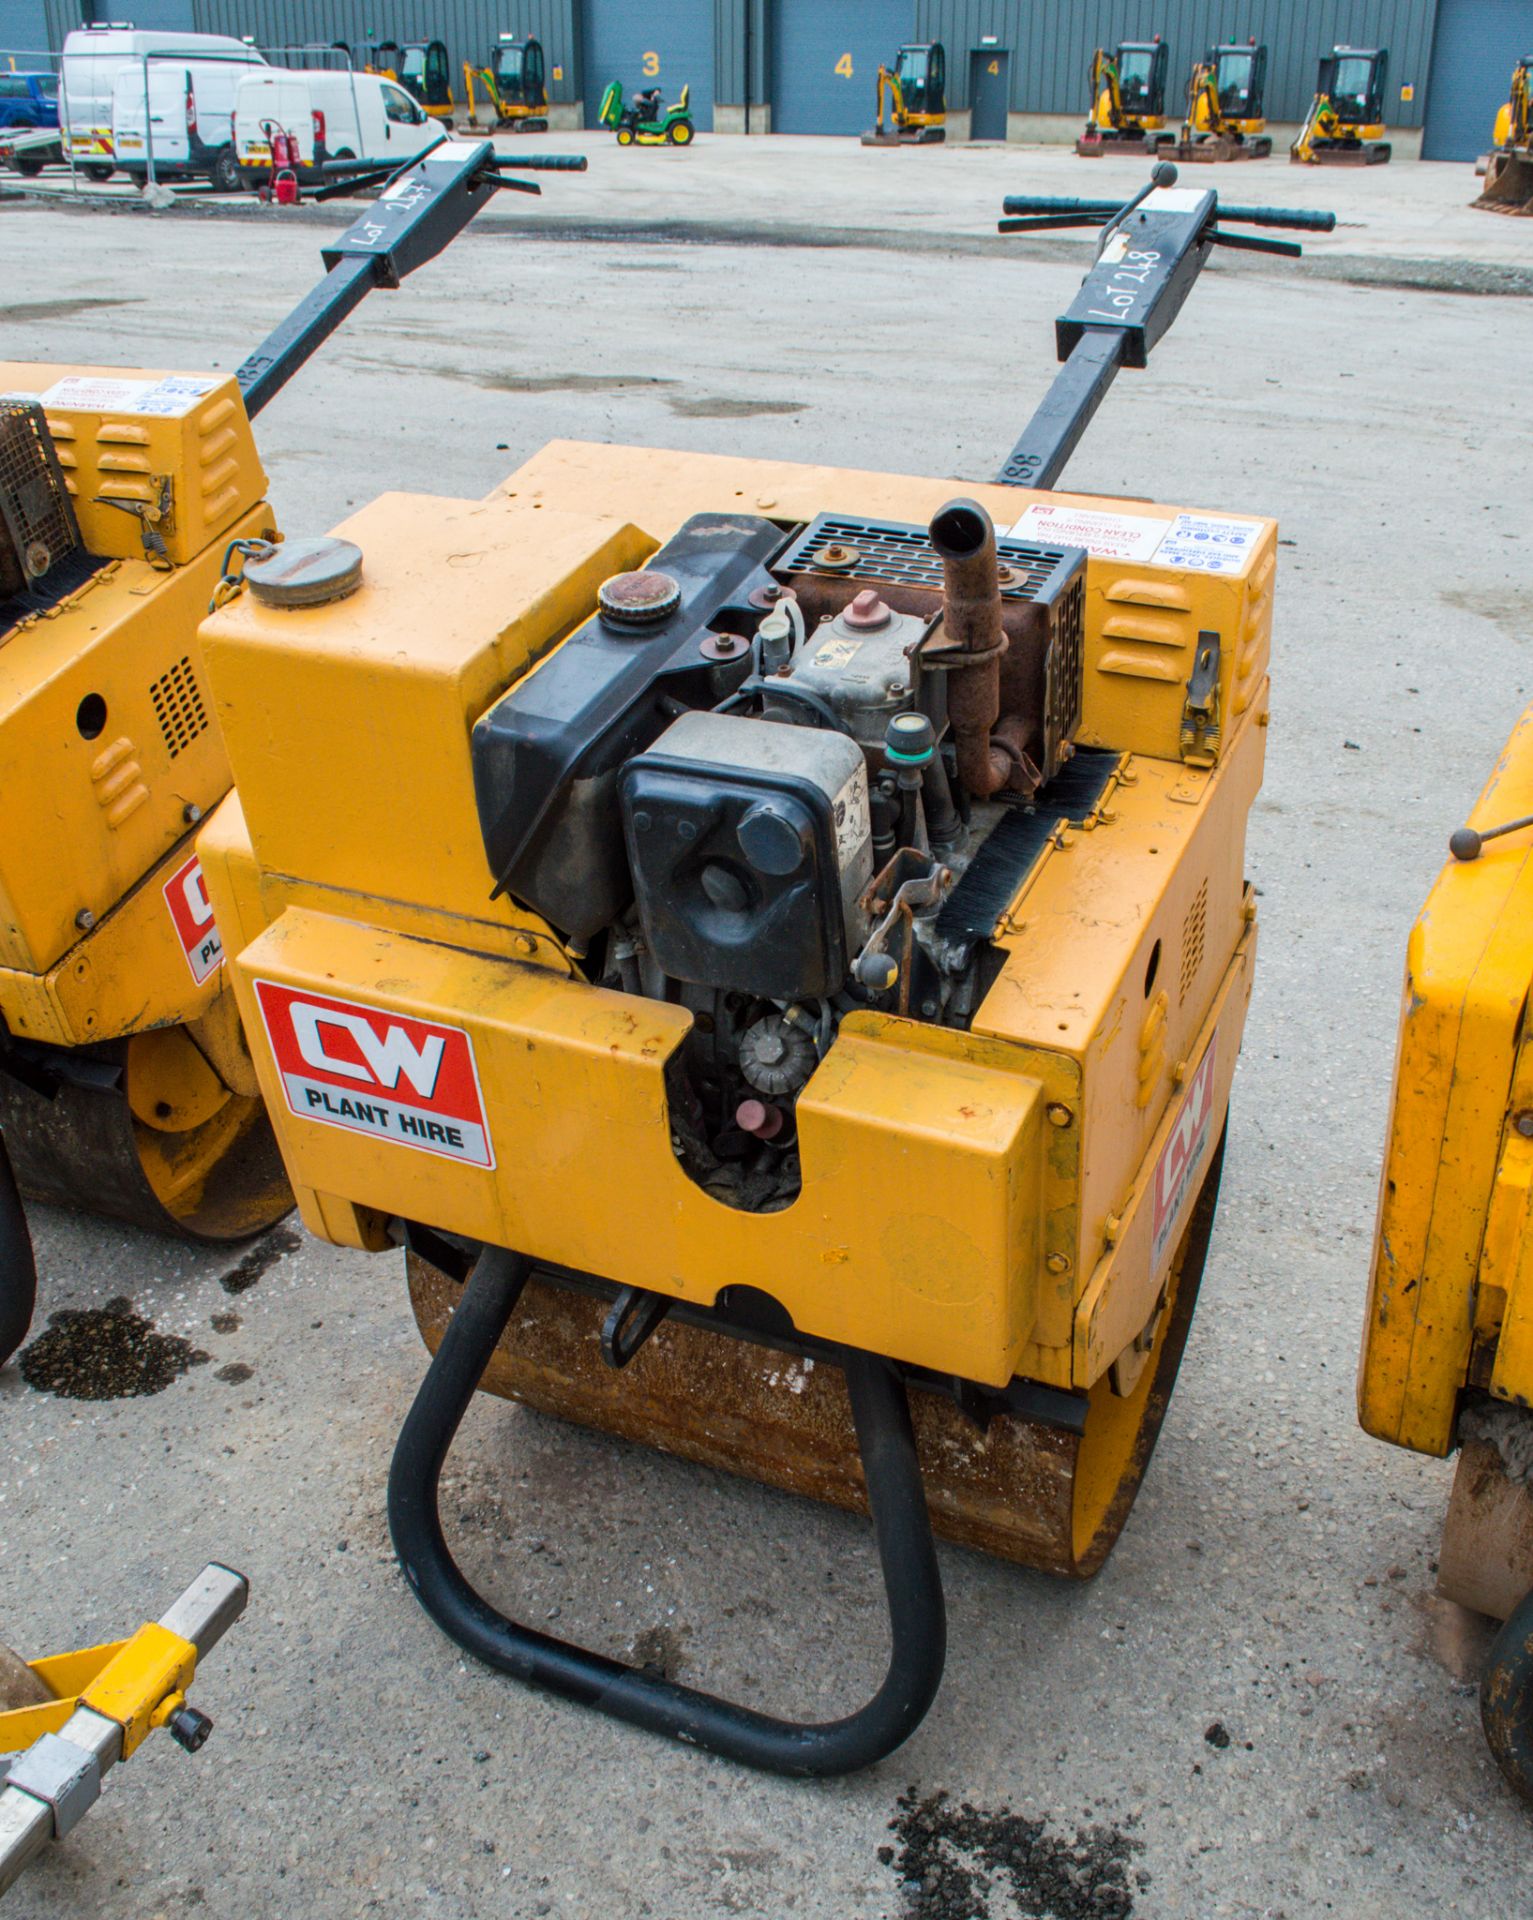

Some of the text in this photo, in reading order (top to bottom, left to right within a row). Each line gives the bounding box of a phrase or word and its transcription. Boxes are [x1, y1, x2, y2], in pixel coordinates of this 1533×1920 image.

[642, 51, 660, 76] 3
[834, 53, 854, 79] 4
[987, 60, 999, 76] 4
[1113, 251, 1161, 284] 248
[1037, 520, 1102, 534] CONDITION
[289, 1001, 446, 1099] CW
[305, 1088, 464, 1149] PLANT HIRE
